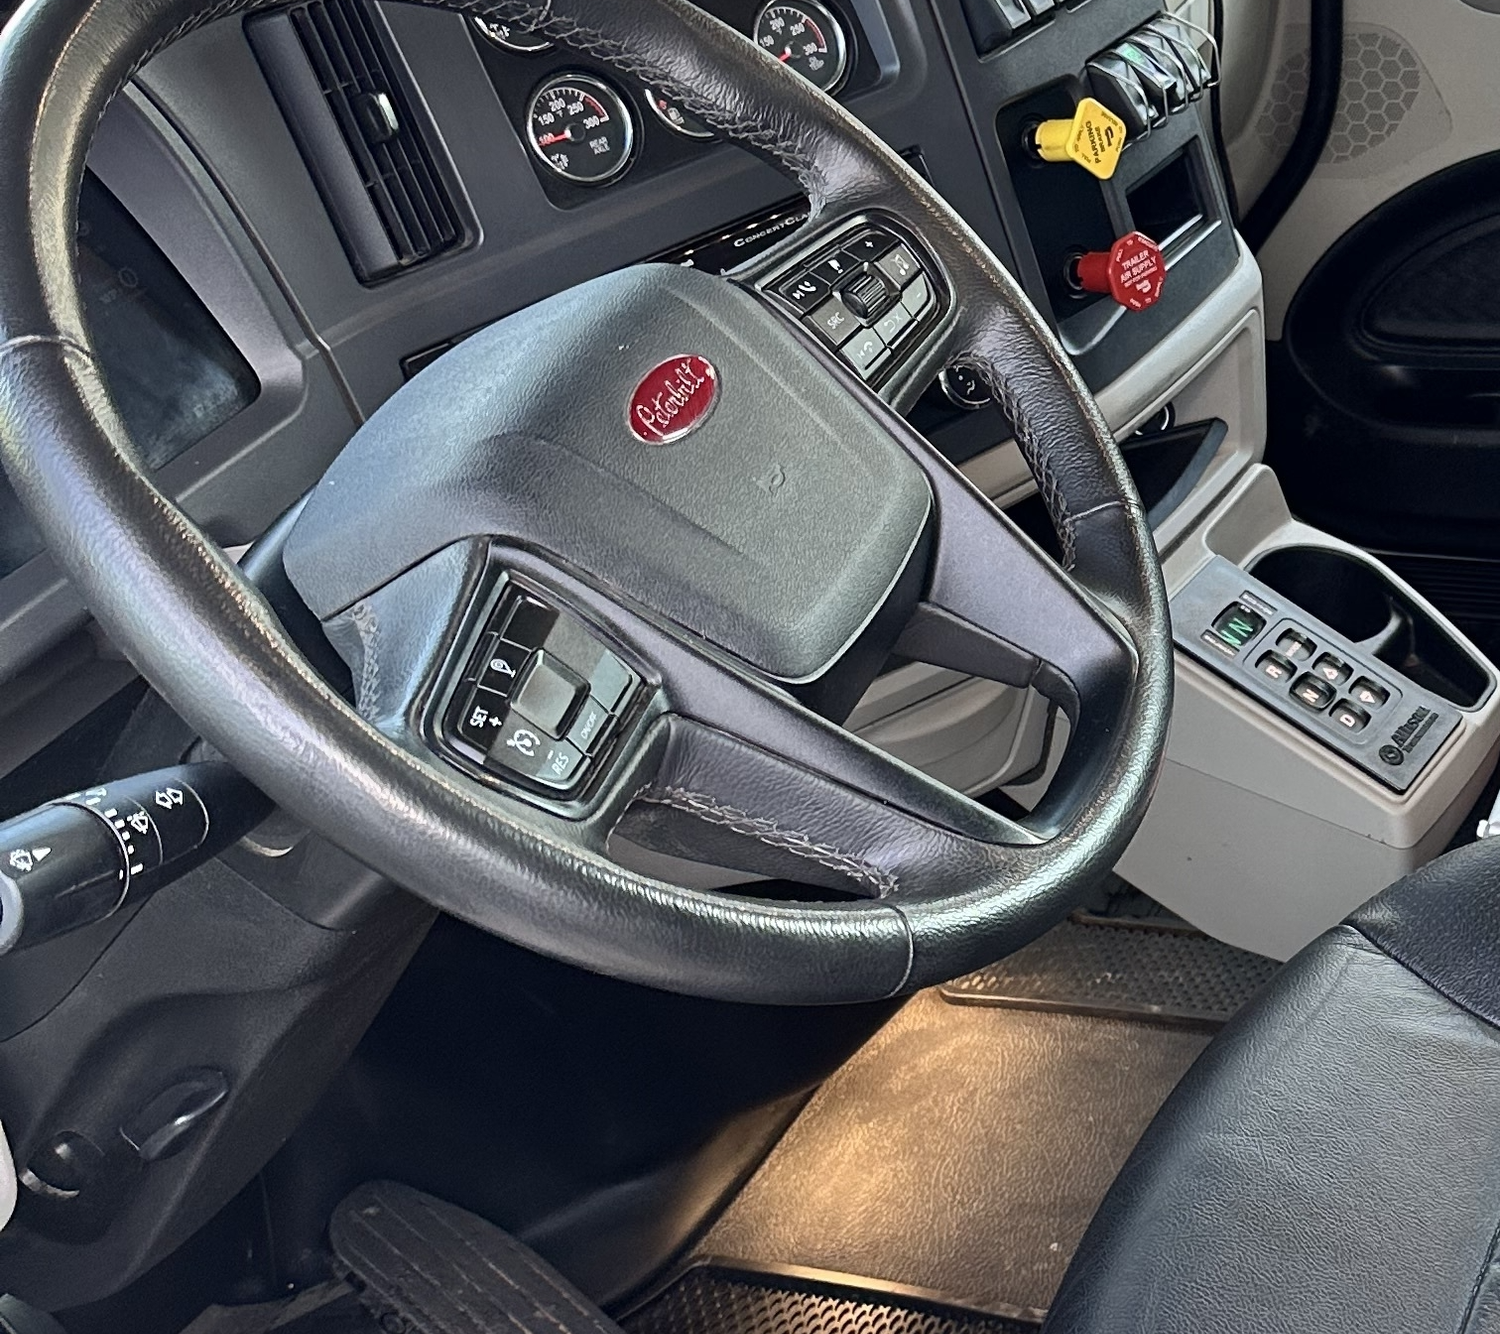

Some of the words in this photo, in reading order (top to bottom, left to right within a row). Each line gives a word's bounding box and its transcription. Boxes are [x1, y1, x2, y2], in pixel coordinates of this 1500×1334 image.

[769, 16, 785, 31] 200
[789, 22, 806, 36] 250
[760, 35, 775, 48] 150
[548, 98, 567, 113] 200
[567, 101, 585, 116] 250
[538, 112, 556, 126] 150
[583, 115, 600, 129] 300
[589, 136, 610, 149] REAR
[1085, 120, 1102, 164] PARKING
[1094, 125, 1106, 153] BRAKE
[593, 143, 611, 155] AXLE
[1121, 249, 1150, 271] TRAILER
[1120, 270, 1133, 284] AIR
[1131, 255, 1157, 276] SUPPLY
[826, 311, 846, 330] SRC
[636, 358, 705, 437] Peterbilt
[1265, 664, 1283, 679] R
[1302, 688, 1320, 703] N
[469, 705, 490, 729] SET
[1339, 713, 1356, 728] D
[1390, 704, 1432, 747] Allison
[551, 753, 570, 776] RES
